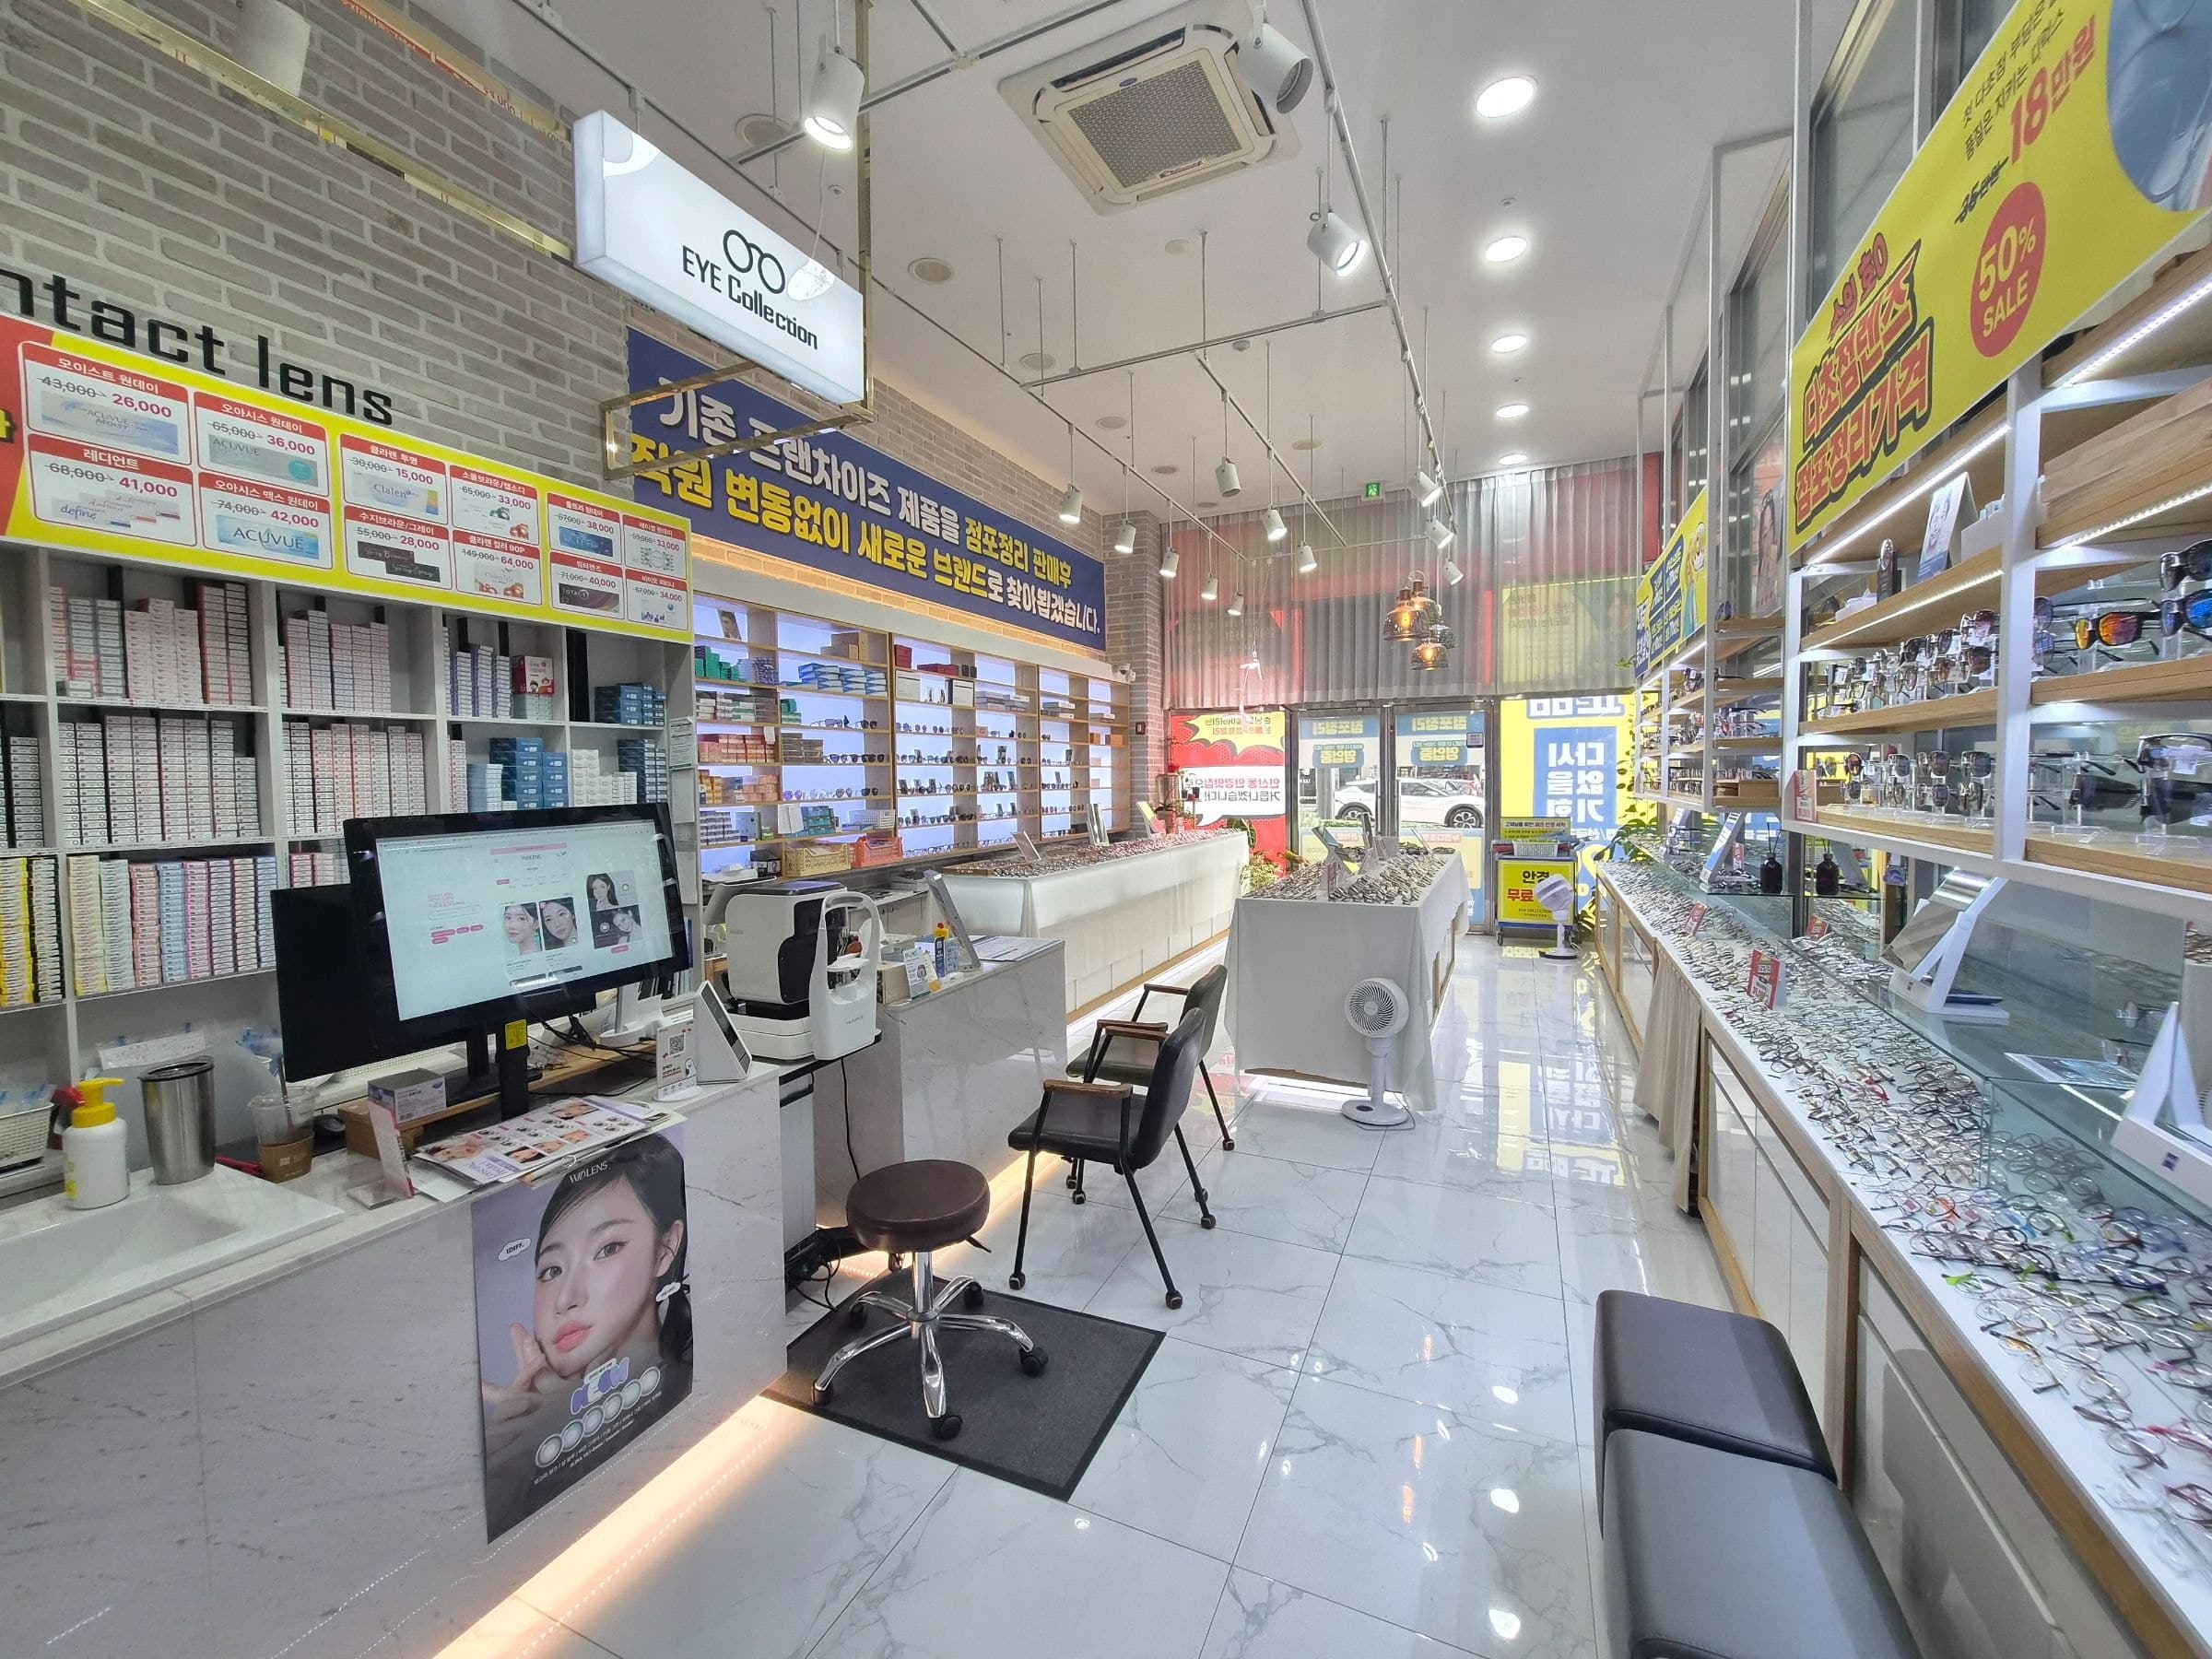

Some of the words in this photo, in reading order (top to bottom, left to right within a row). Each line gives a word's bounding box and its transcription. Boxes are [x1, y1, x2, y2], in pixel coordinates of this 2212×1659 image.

[1975, 52, 2006, 104] 다초점
[2011, 15, 2096, 166] 18만원
[1964, 109, 1994, 161] 품질은
[1995, 65, 2028, 115] 지키는
[1978, 216, 2036, 305] 50%
[682, 245, 722, 294] EYE
[728, 275, 818, 350] Collection
[1983, 272, 2029, 338] SALE
[1804, 247, 1915, 444] 다초점렌즈
[58, 358, 114, 382] 모이스트
[119, 376, 159, 394] 원데이
[257, 335, 393, 425] lens
[42, 376, 96, 398] 43,000
[112, 394, 172, 418] 26,000
[221, 404, 268, 424] 오아시스
[270, 417, 302, 434] 원데이
[1796, 330, 1930, 528] 점포정리가격
[212, 421, 256, 440] 65,000
[267, 434, 316, 455] 36,000
[213, 438, 260, 456] ACUVUE
[83, 449, 140, 470] 레디언트
[395, 468, 433, 485] 15,000
[50, 463, 105, 482] 68,000
[119, 477, 178, 498] 41,000
[215, 479, 260, 497] 오아시스
[263, 489, 285, 503] 맥스
[288, 495, 318, 511] 원데이
[658, 377, 736, 445] 기존
[747, 417, 891, 517] 프랜차이즈
[898, 485, 960, 547] 제품을
[964, 516, 1030, 574] 점포정리
[1032, 549, 1072, 590] 판매후
[498, 494, 531, 510] 33,000
[270, 511, 319, 528] 42,000
[359, 512, 434, 535] 수지브라운/그레이
[587, 521, 614, 534] 38,000
[629, 434, 713, 509] 직원
[725, 467, 850, 555] 변동없이
[858, 520, 927, 574] 새로운
[933, 550, 1006, 605] 브랜드로
[1006, 575, 1100, 635] 찾아뵙겠습니다.
[233, 526, 305, 550] ACUVUE
[357, 526, 391, 540] 55,000
[400, 535, 440, 550] 28,000
[500, 556, 534, 570] 64,000
[589, 576, 616, 588] 40,000
[1508, 888, 1535, 902] 무료
